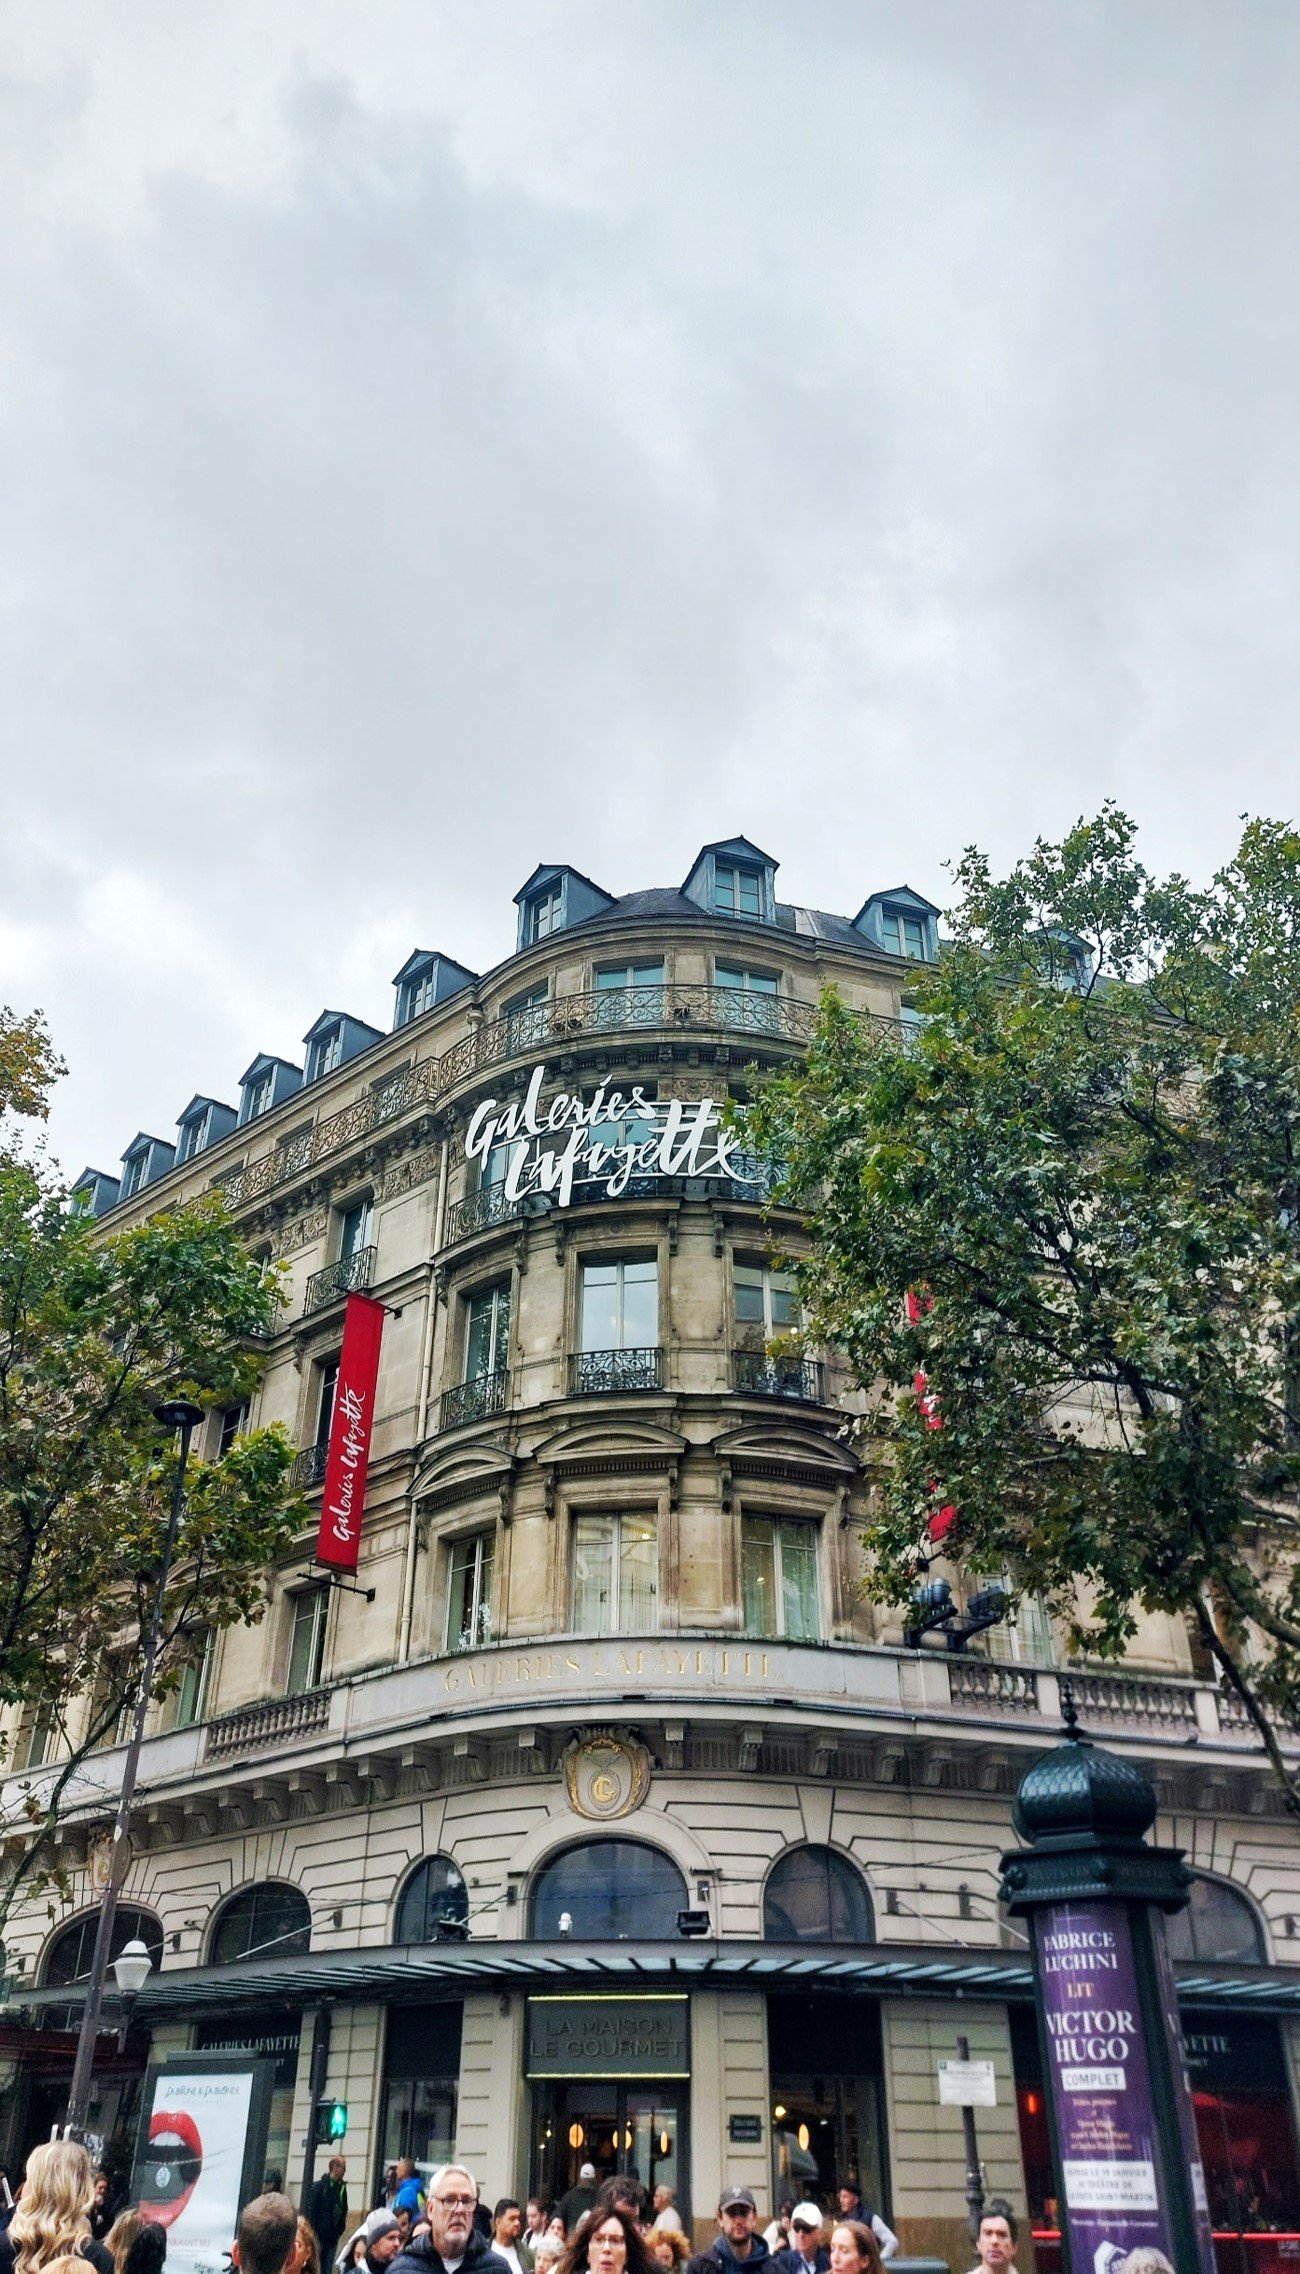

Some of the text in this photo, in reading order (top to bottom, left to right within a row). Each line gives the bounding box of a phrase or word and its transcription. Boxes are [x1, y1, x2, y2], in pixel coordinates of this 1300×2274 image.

[465, 1066, 657, 1170] Galeries
[504, 1099, 766, 1207] Lafayette
[328, 1381, 366, 1542] Galeries Lafayette
[444, 1650, 782, 1693] GALERIES LAFAYETTE
[1043, 1931, 1116, 1952] FABRICE
[1045, 1952, 1118, 1973] LUCHINI
[1067, 1982, 1094, 1999] LIT
[545, 2017, 673, 2036] LA MAISON
[1046, 2009, 1137, 2036] VICTOR
[530, 2039, 685, 2058] LE GOURMET
[1055, 2037, 1129, 2062] HUGO
[1065, 2073, 1120, 2086] COMPLET
